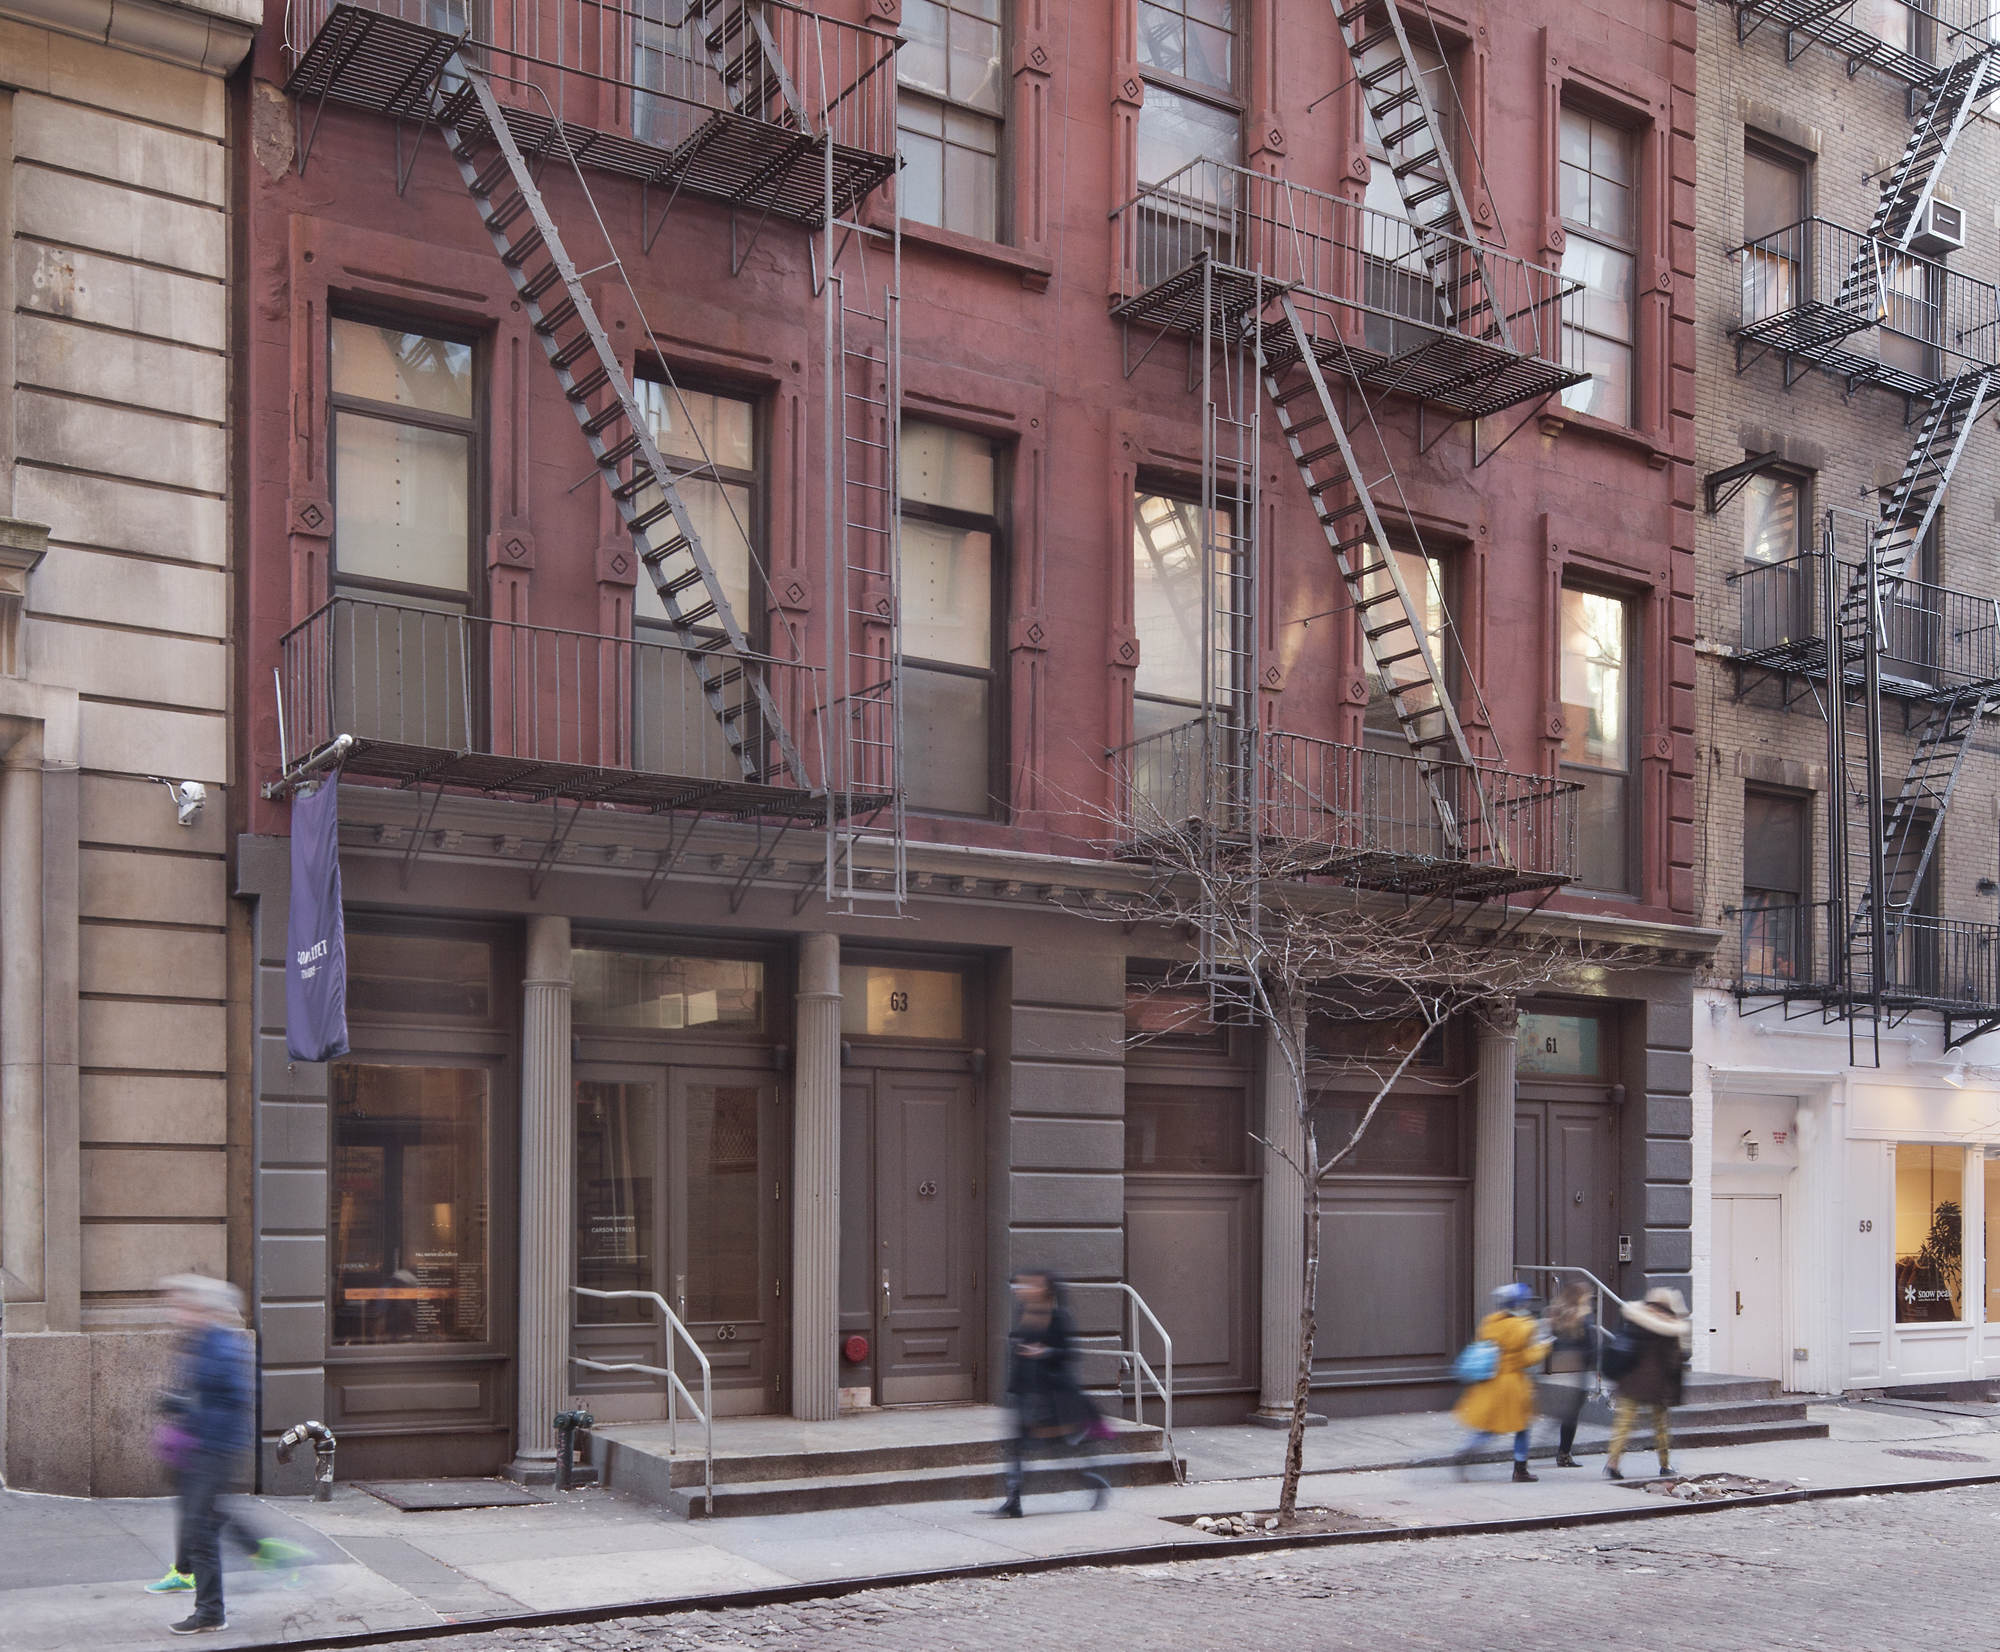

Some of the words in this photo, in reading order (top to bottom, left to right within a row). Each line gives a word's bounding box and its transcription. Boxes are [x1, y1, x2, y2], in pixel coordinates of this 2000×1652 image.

[890, 991, 908, 1011] 63
[1546, 1036, 1558, 1053] 61
[919, 1180, 937, 1195] 63
[1859, 1219, 1872, 1233] 59
[1917, 1290, 1936, 1299] snow
[1936, 1286, 1953, 1302] peak
[717, 1325, 736, 1340] 63
